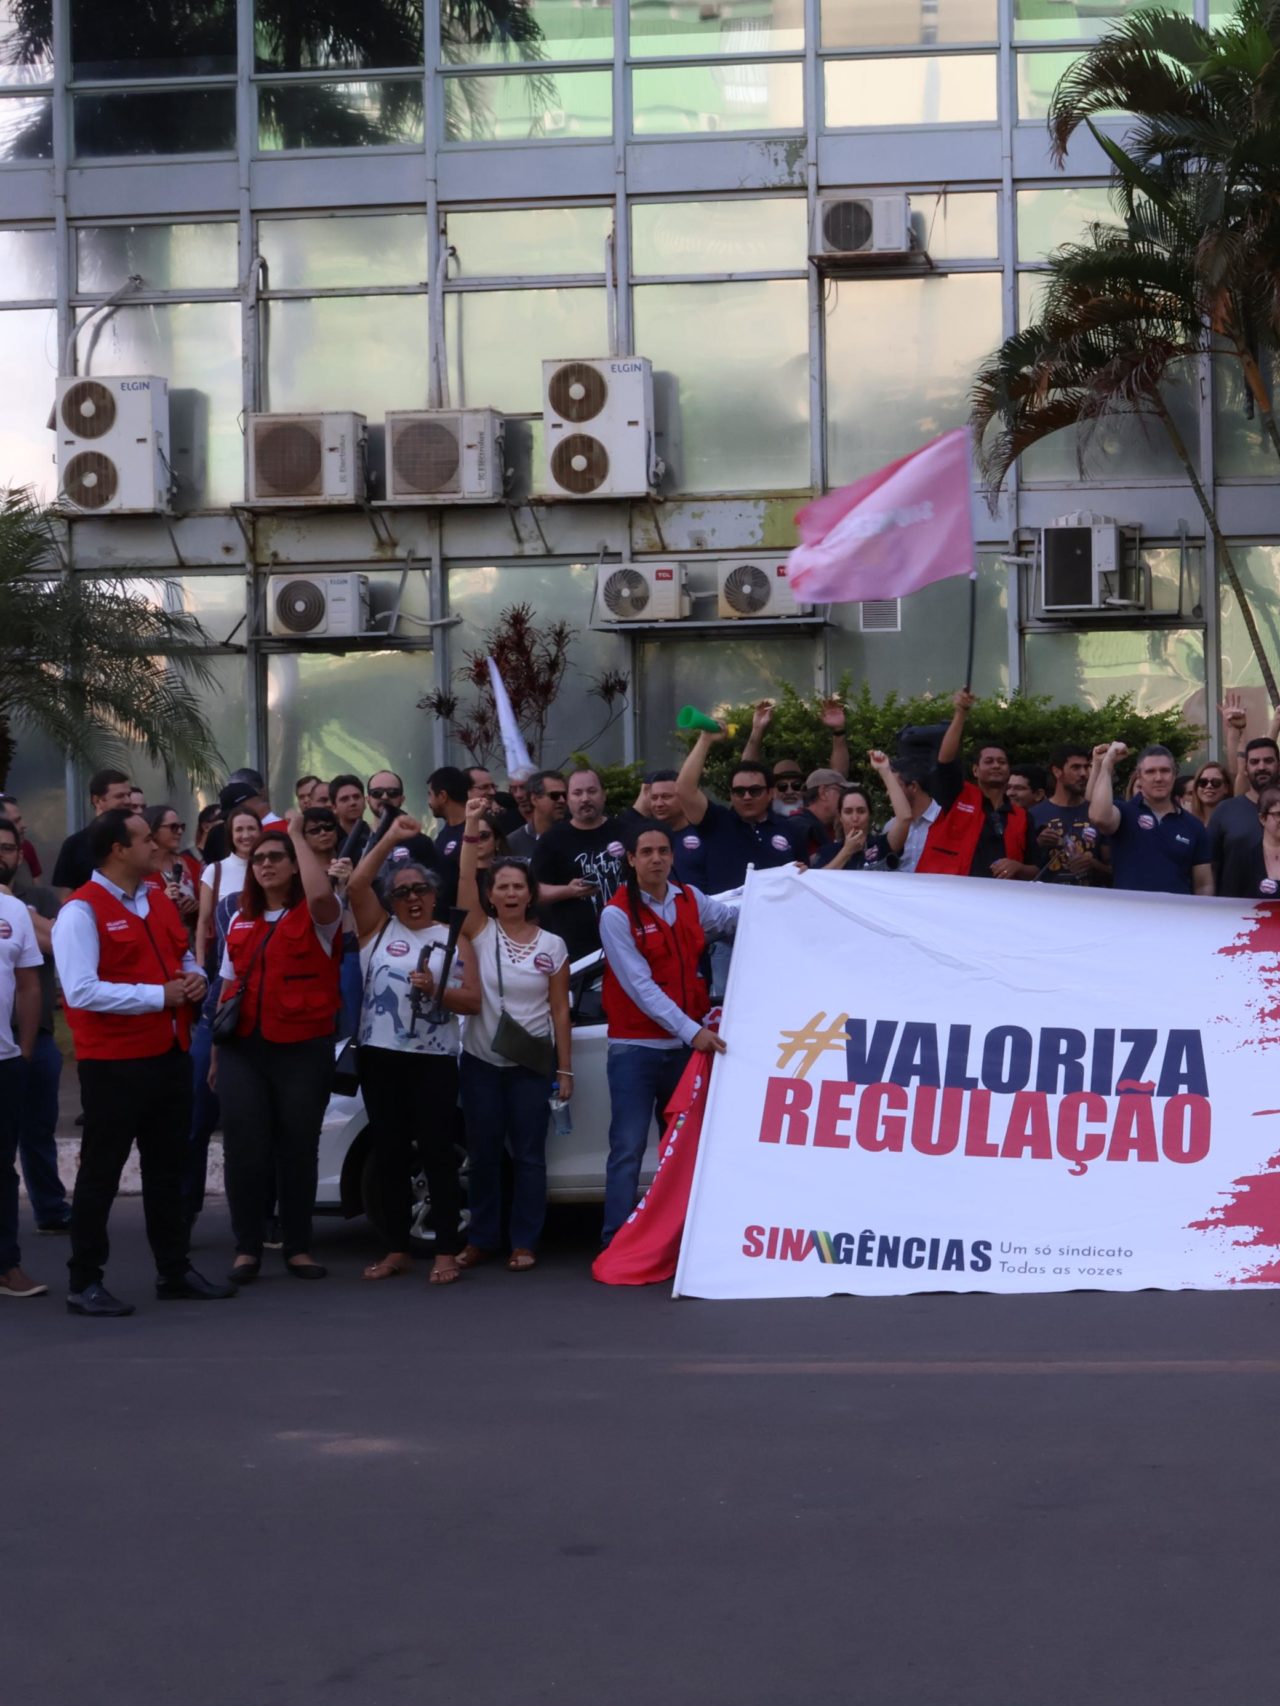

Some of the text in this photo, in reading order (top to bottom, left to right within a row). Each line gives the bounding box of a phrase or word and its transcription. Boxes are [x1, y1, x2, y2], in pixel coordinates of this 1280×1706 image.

[612, 363, 642, 373] ELGIN
[120, 381, 150, 392] ELGIN
[776, 1010, 1210, 1098] #VALORIZA
[758, 1076, 1212, 1176] REGULAÇÃO
[742, 1224, 993, 1273] SINAGÊNCIAS
[1000, 1241, 1134, 1258] Um só sindicato
[999, 1261, 1123, 1276] Todas as vozes
